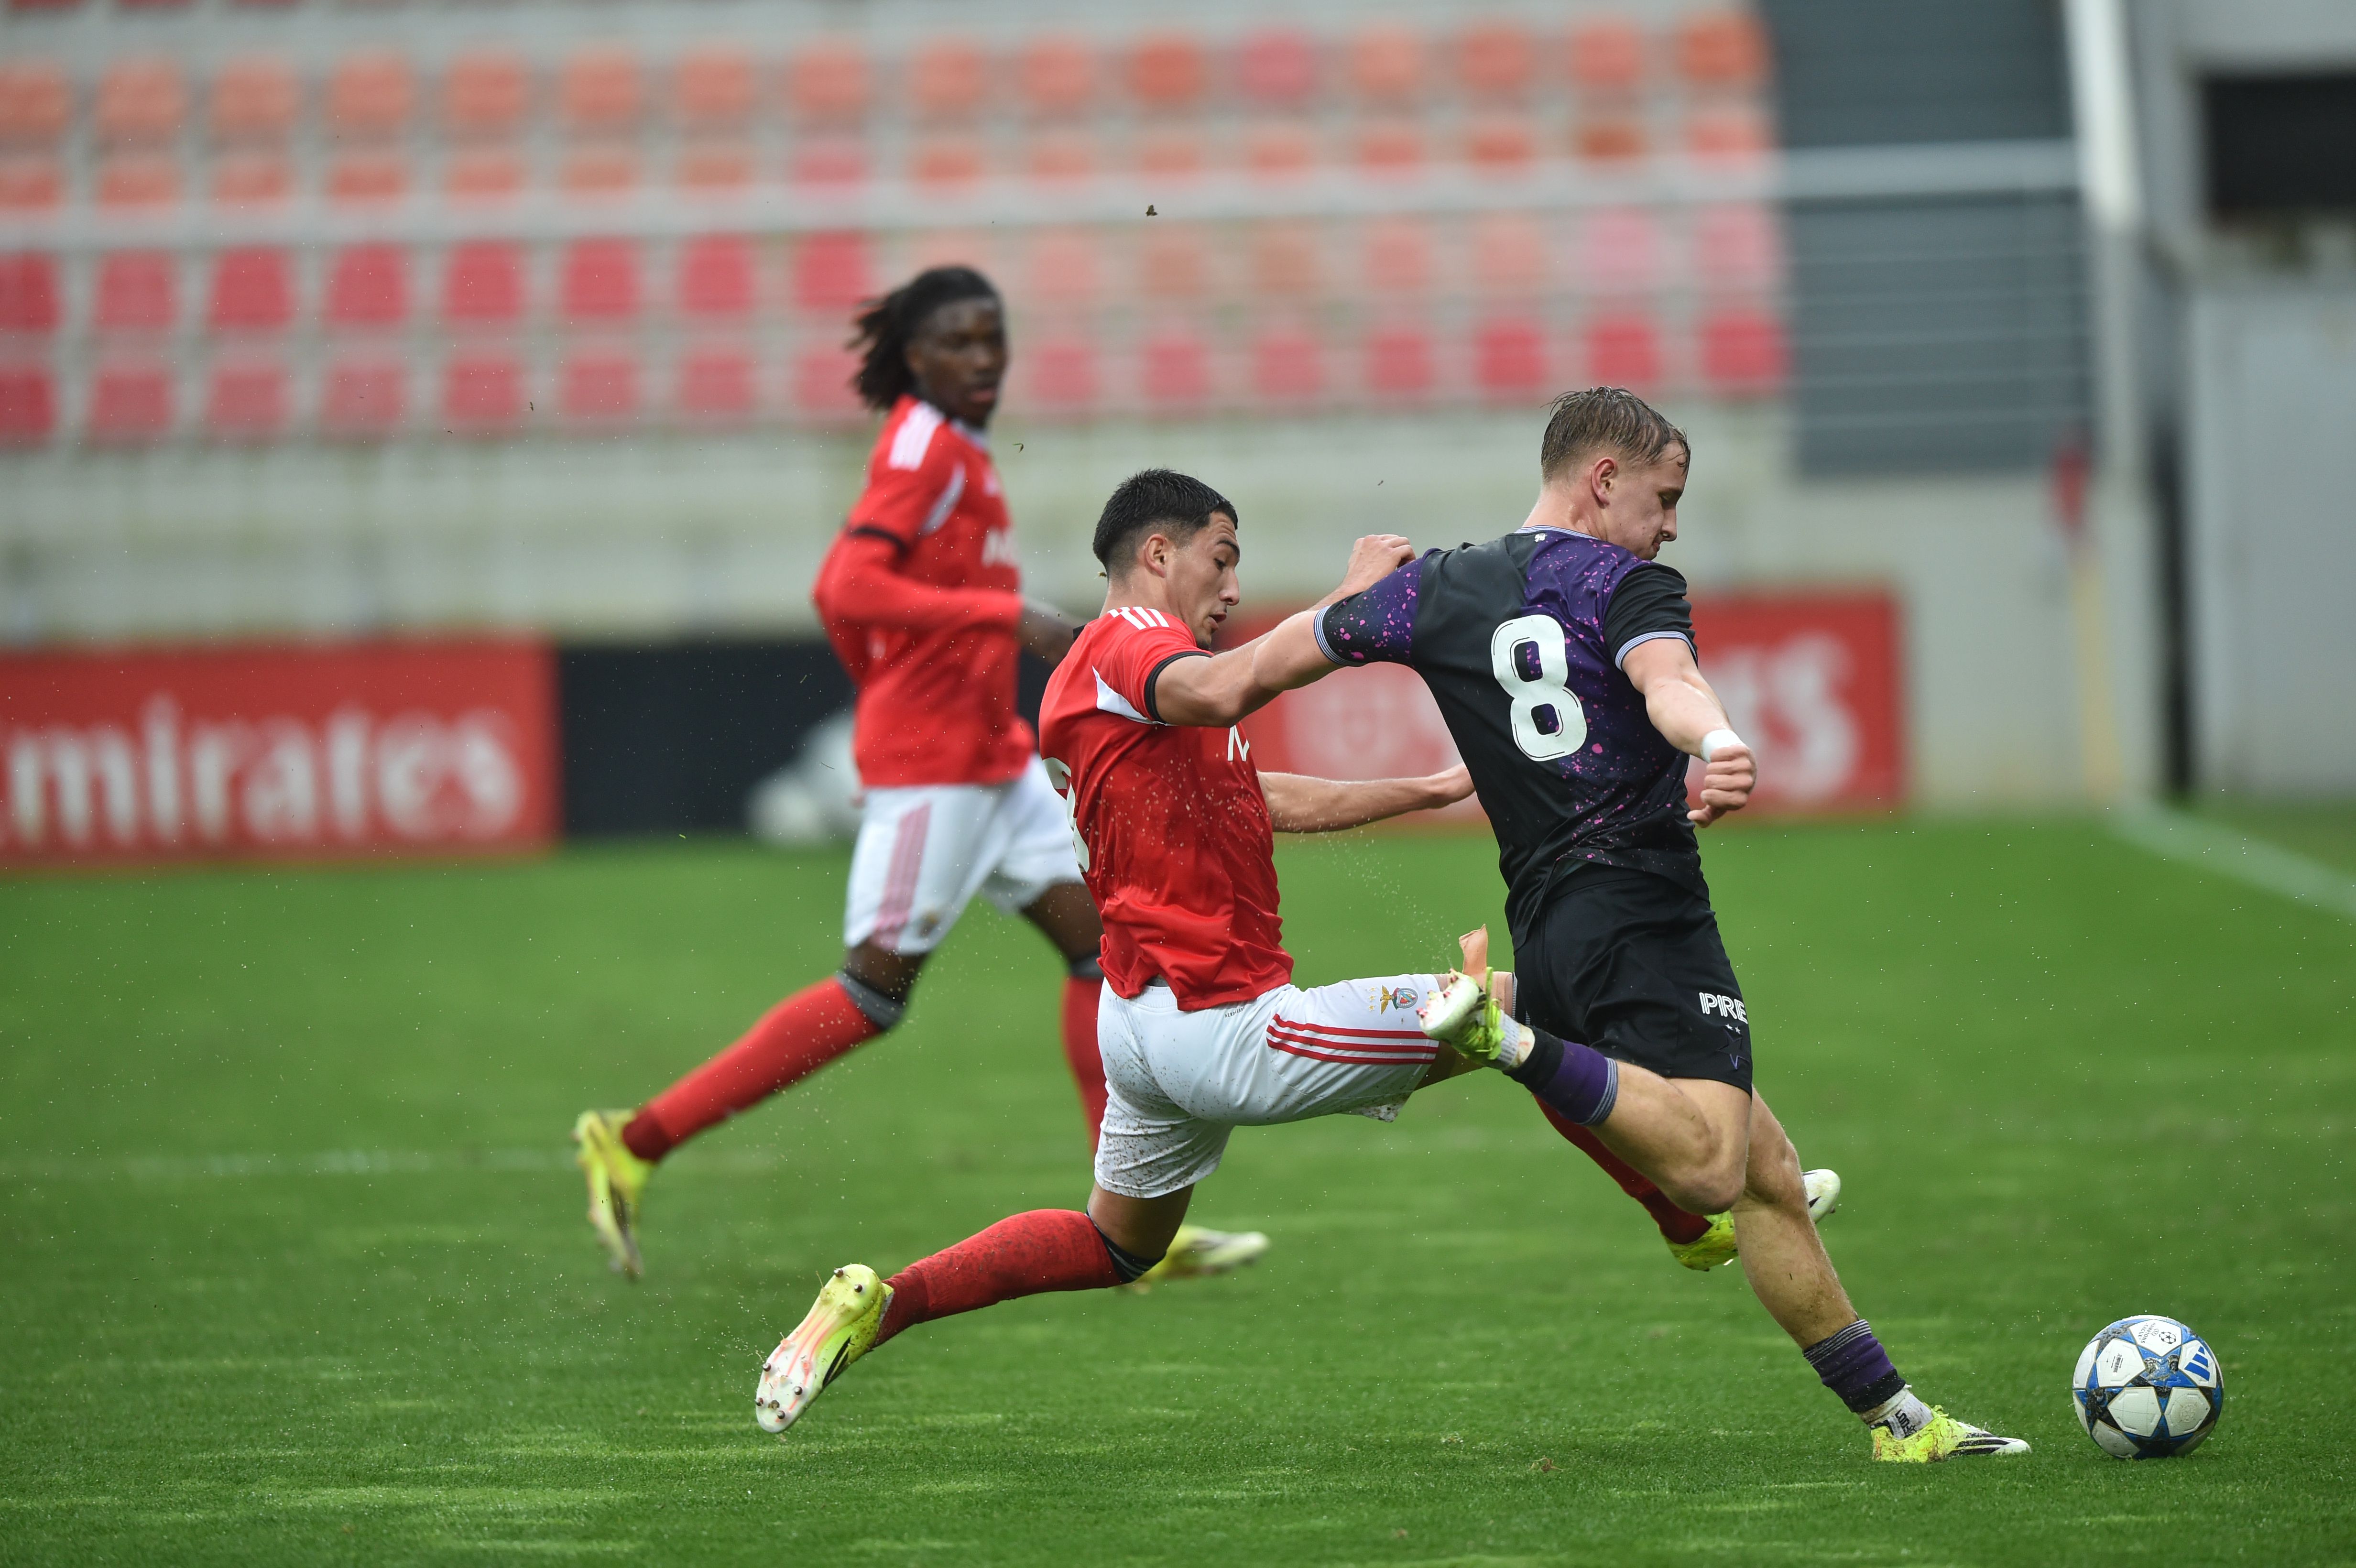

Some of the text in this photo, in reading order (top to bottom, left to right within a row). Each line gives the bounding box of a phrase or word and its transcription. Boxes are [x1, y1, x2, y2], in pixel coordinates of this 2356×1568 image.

[1491, 614, 1587, 762] 8
[0, 694, 519, 844] mirates
[1699, 992, 1748, 1024] PRE
[2138, 1323, 2149, 1338] EAGUE
[2140, 1321, 2157, 1343] HAMPIONS
